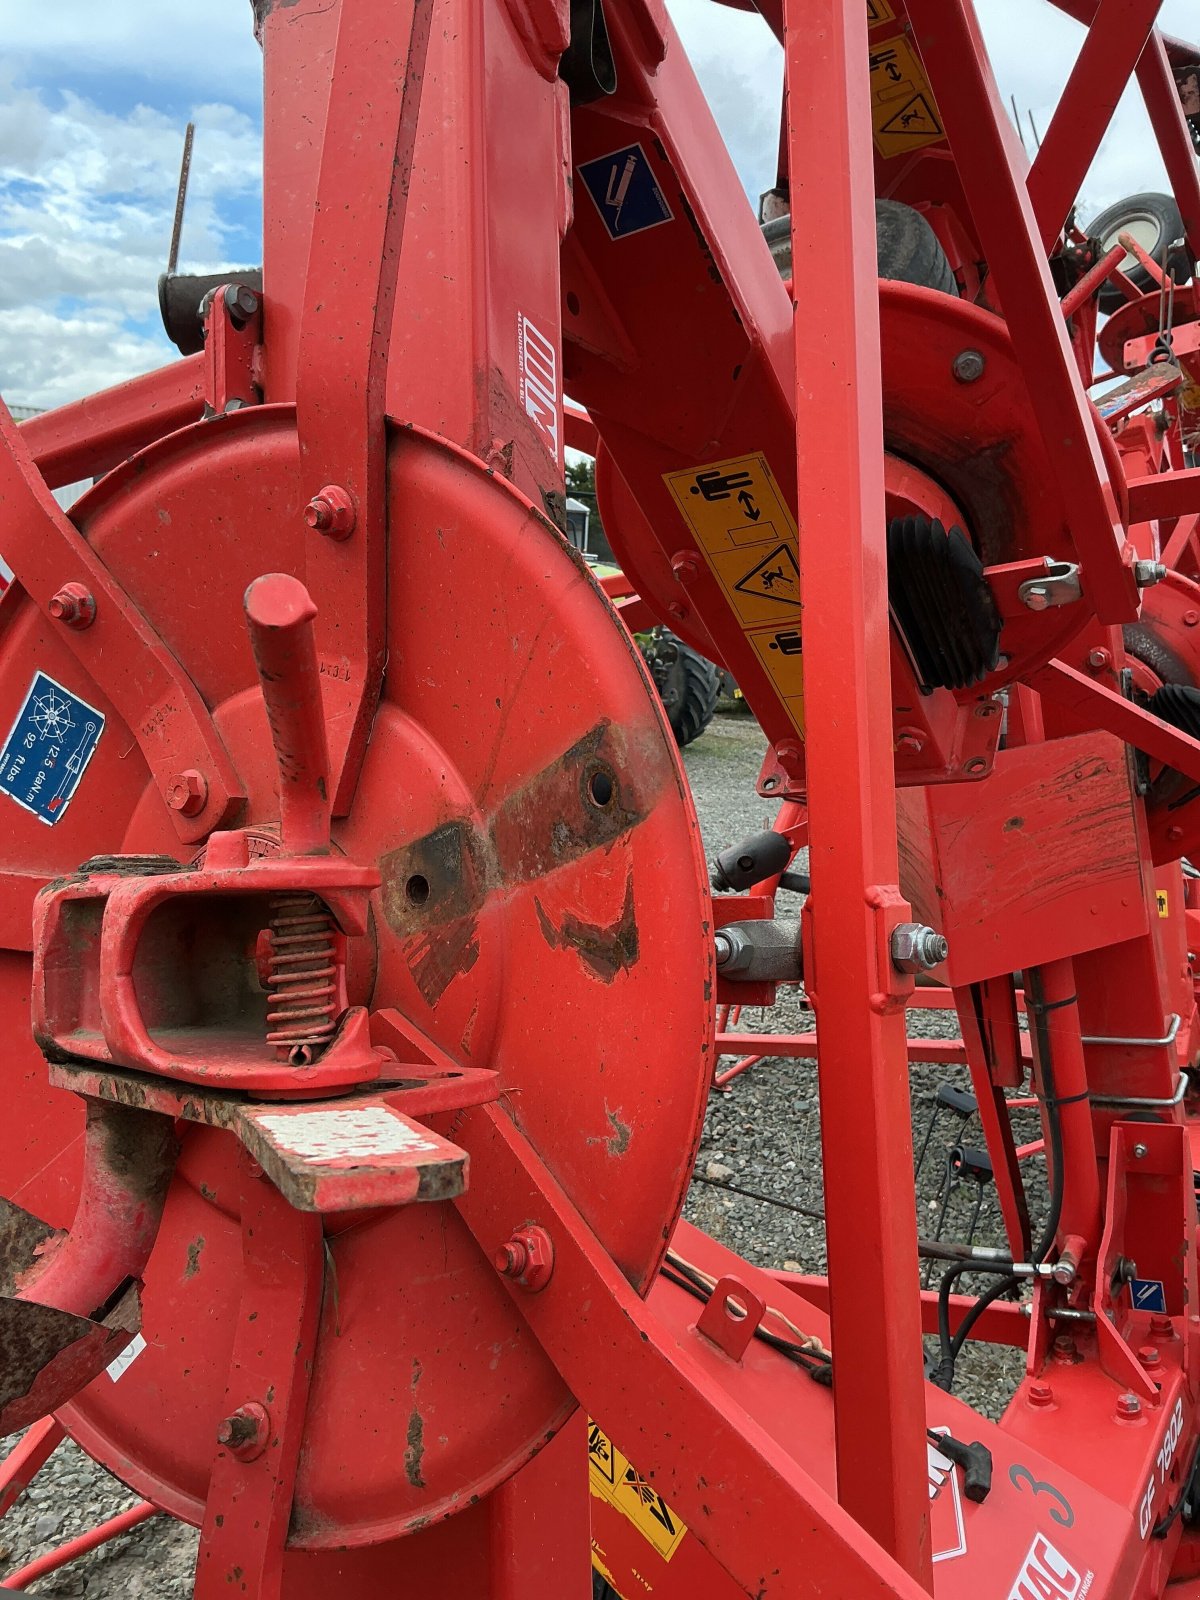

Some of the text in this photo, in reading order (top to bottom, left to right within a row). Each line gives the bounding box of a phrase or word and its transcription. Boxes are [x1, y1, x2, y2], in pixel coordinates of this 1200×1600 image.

[6, 732, 37, 783] 92 ft.lbs
[26, 744, 60, 803] 12.5 daN.m
[1008, 1463, 1075, 1528] 3
[1139, 1397, 1183, 1540] GF 7802
